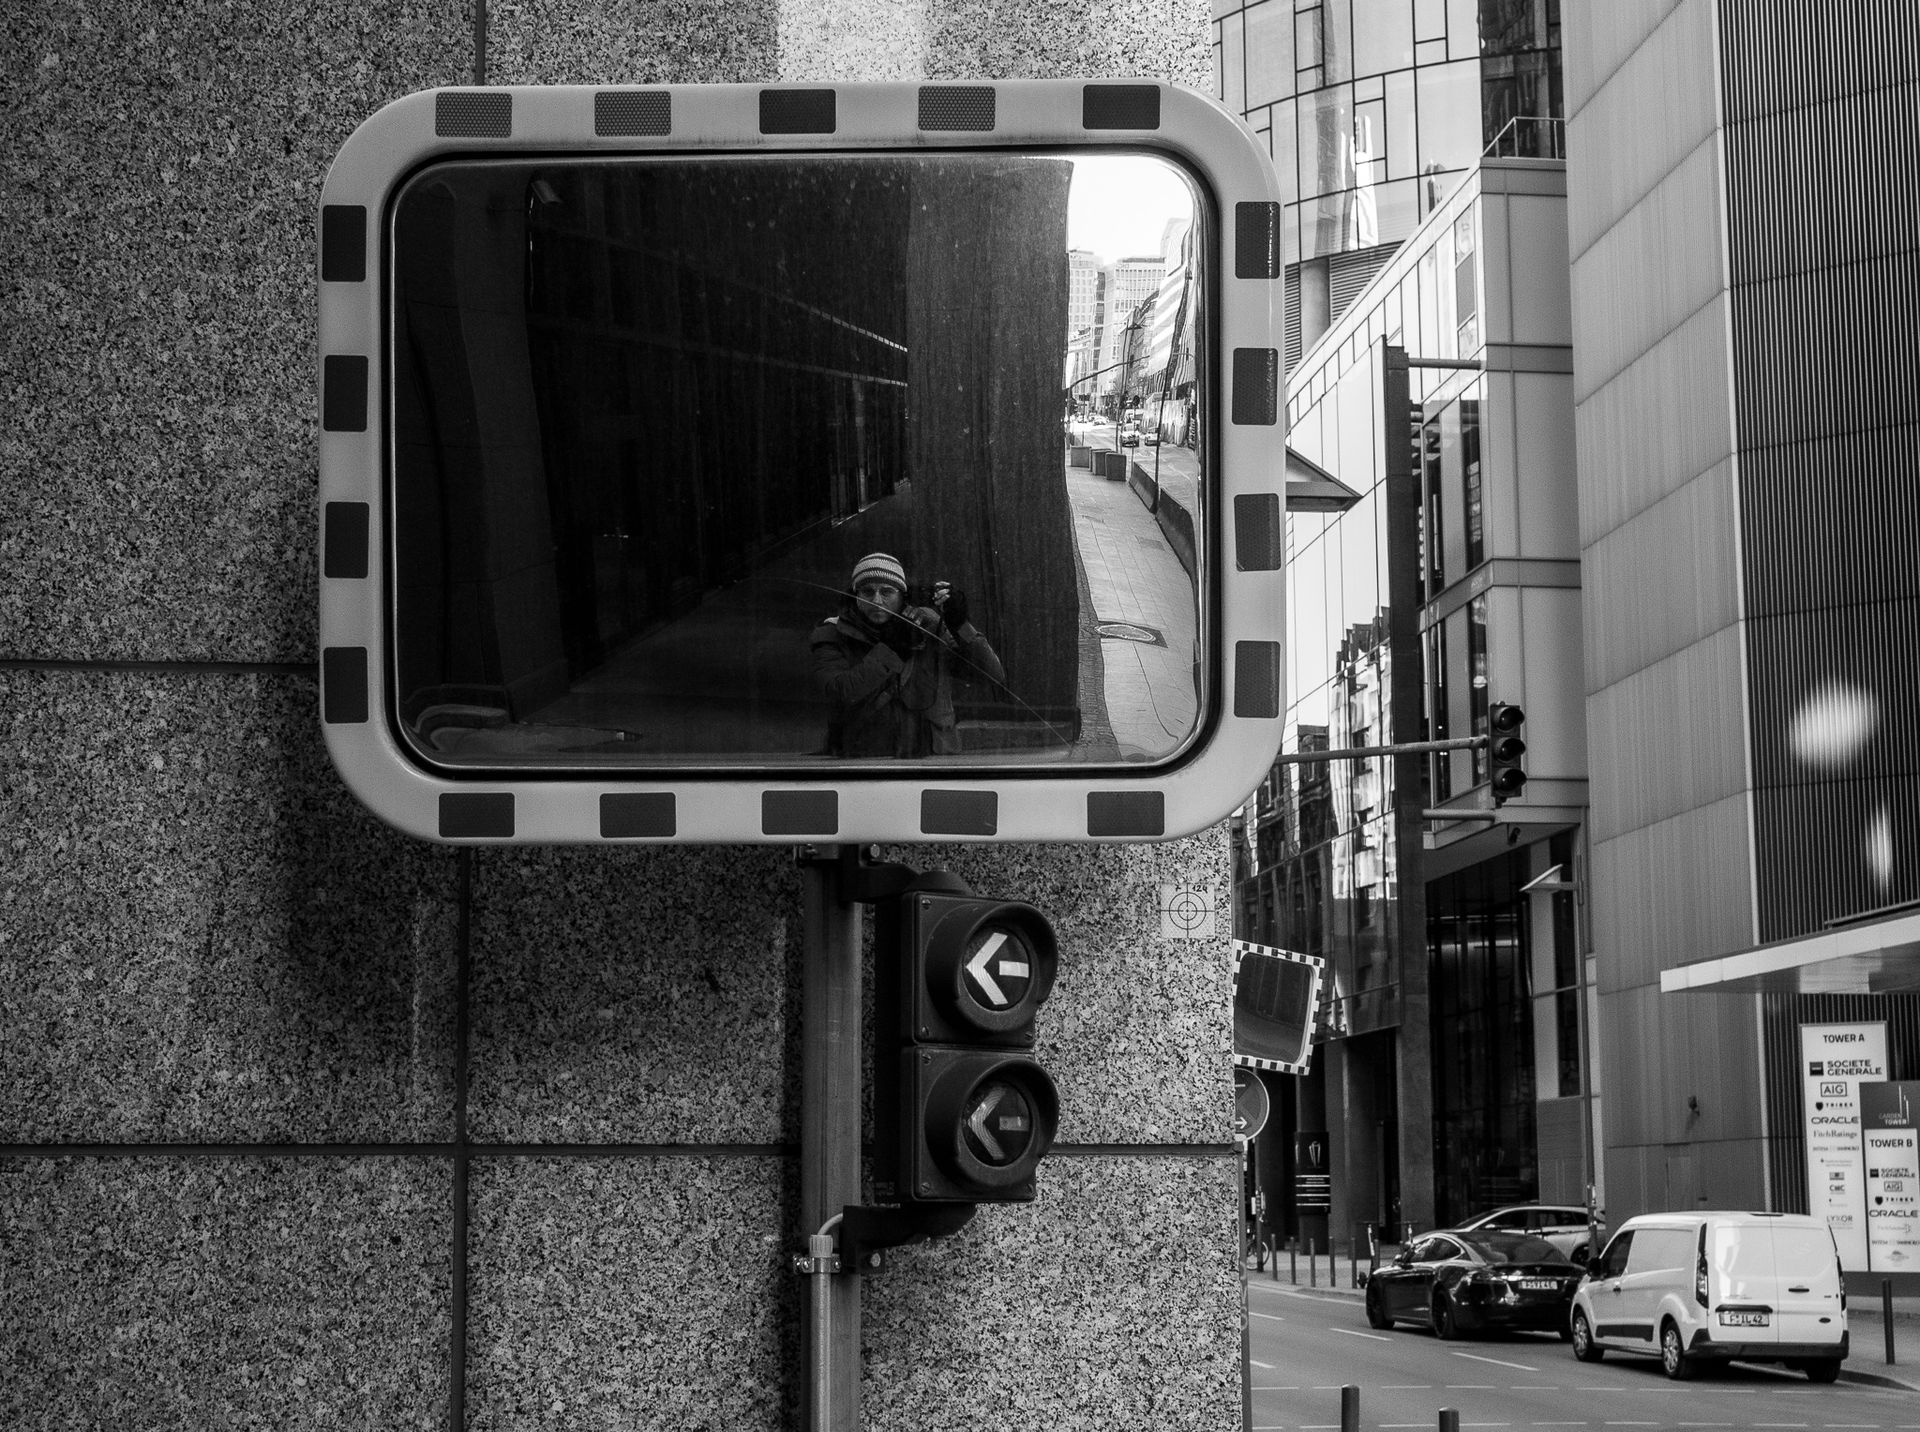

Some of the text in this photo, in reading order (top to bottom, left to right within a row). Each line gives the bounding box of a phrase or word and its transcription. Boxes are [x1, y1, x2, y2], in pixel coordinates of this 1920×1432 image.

[1823, 1033, 1865, 1043] TOWER A
[1827, 1067, 1882, 1076] GENERALE
[1823, 1085, 1844, 1094] AIG
[1811, 1116, 1859, 1124] ORACLE
[1869, 1139, 1913, 1148] TOWER B
[1869, 1210, 1918, 1218] ORACLE
